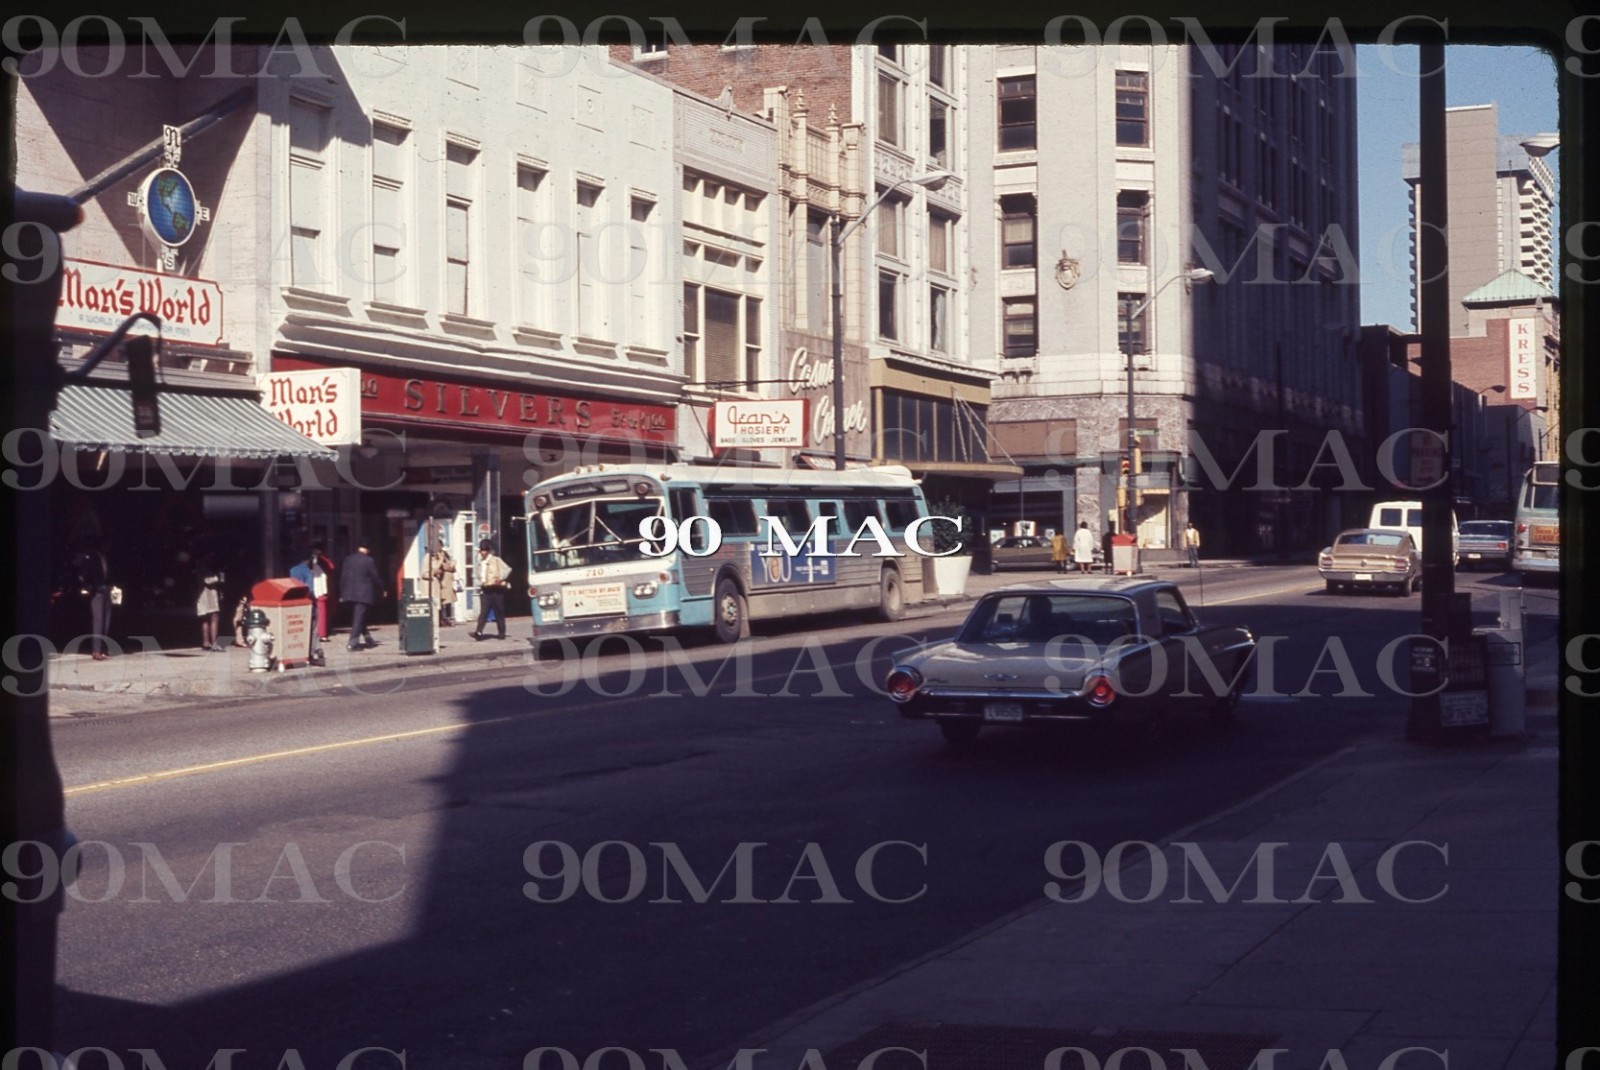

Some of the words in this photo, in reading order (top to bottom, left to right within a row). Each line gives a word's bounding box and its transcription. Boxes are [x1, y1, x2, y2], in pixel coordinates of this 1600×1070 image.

[58, 266, 135, 316] Man's
[138, 277, 211, 326] World
[1517, 323, 1529, 393] KRESS
[270, 376, 338, 406] Man's
[404, 378, 592, 428] SILVERS
[727, 405, 790, 434] Jean's
[740, 426, 787, 434] HOSIERY
[586, 567, 604, 577] 710
